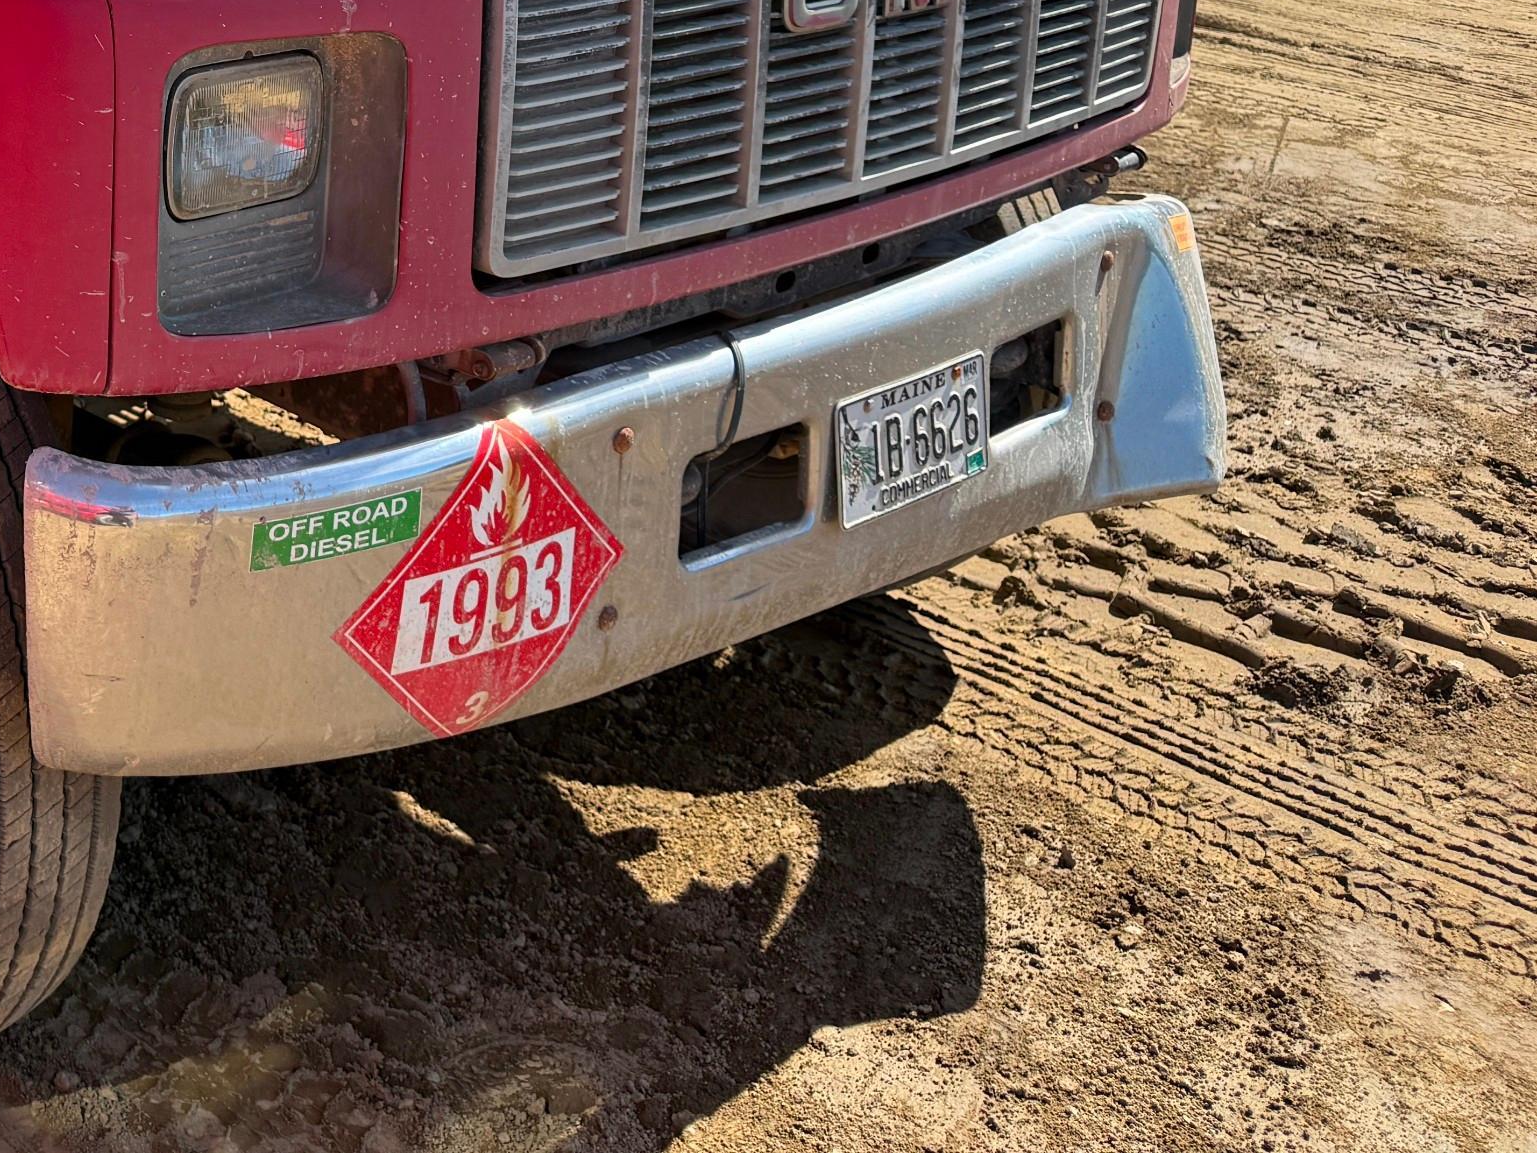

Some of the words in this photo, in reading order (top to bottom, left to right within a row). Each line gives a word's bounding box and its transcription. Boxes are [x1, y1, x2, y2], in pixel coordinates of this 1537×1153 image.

[880, 372, 946, 410] MAINE
[880, 462, 954, 507] COMMERCIAL
[268, 516, 323, 543] OFF
[332, 496, 409, 530] ROAD
[289, 528, 388, 563] DIESEL
[417, 540, 563, 665] 1993
[455, 690, 490, 725] 3
